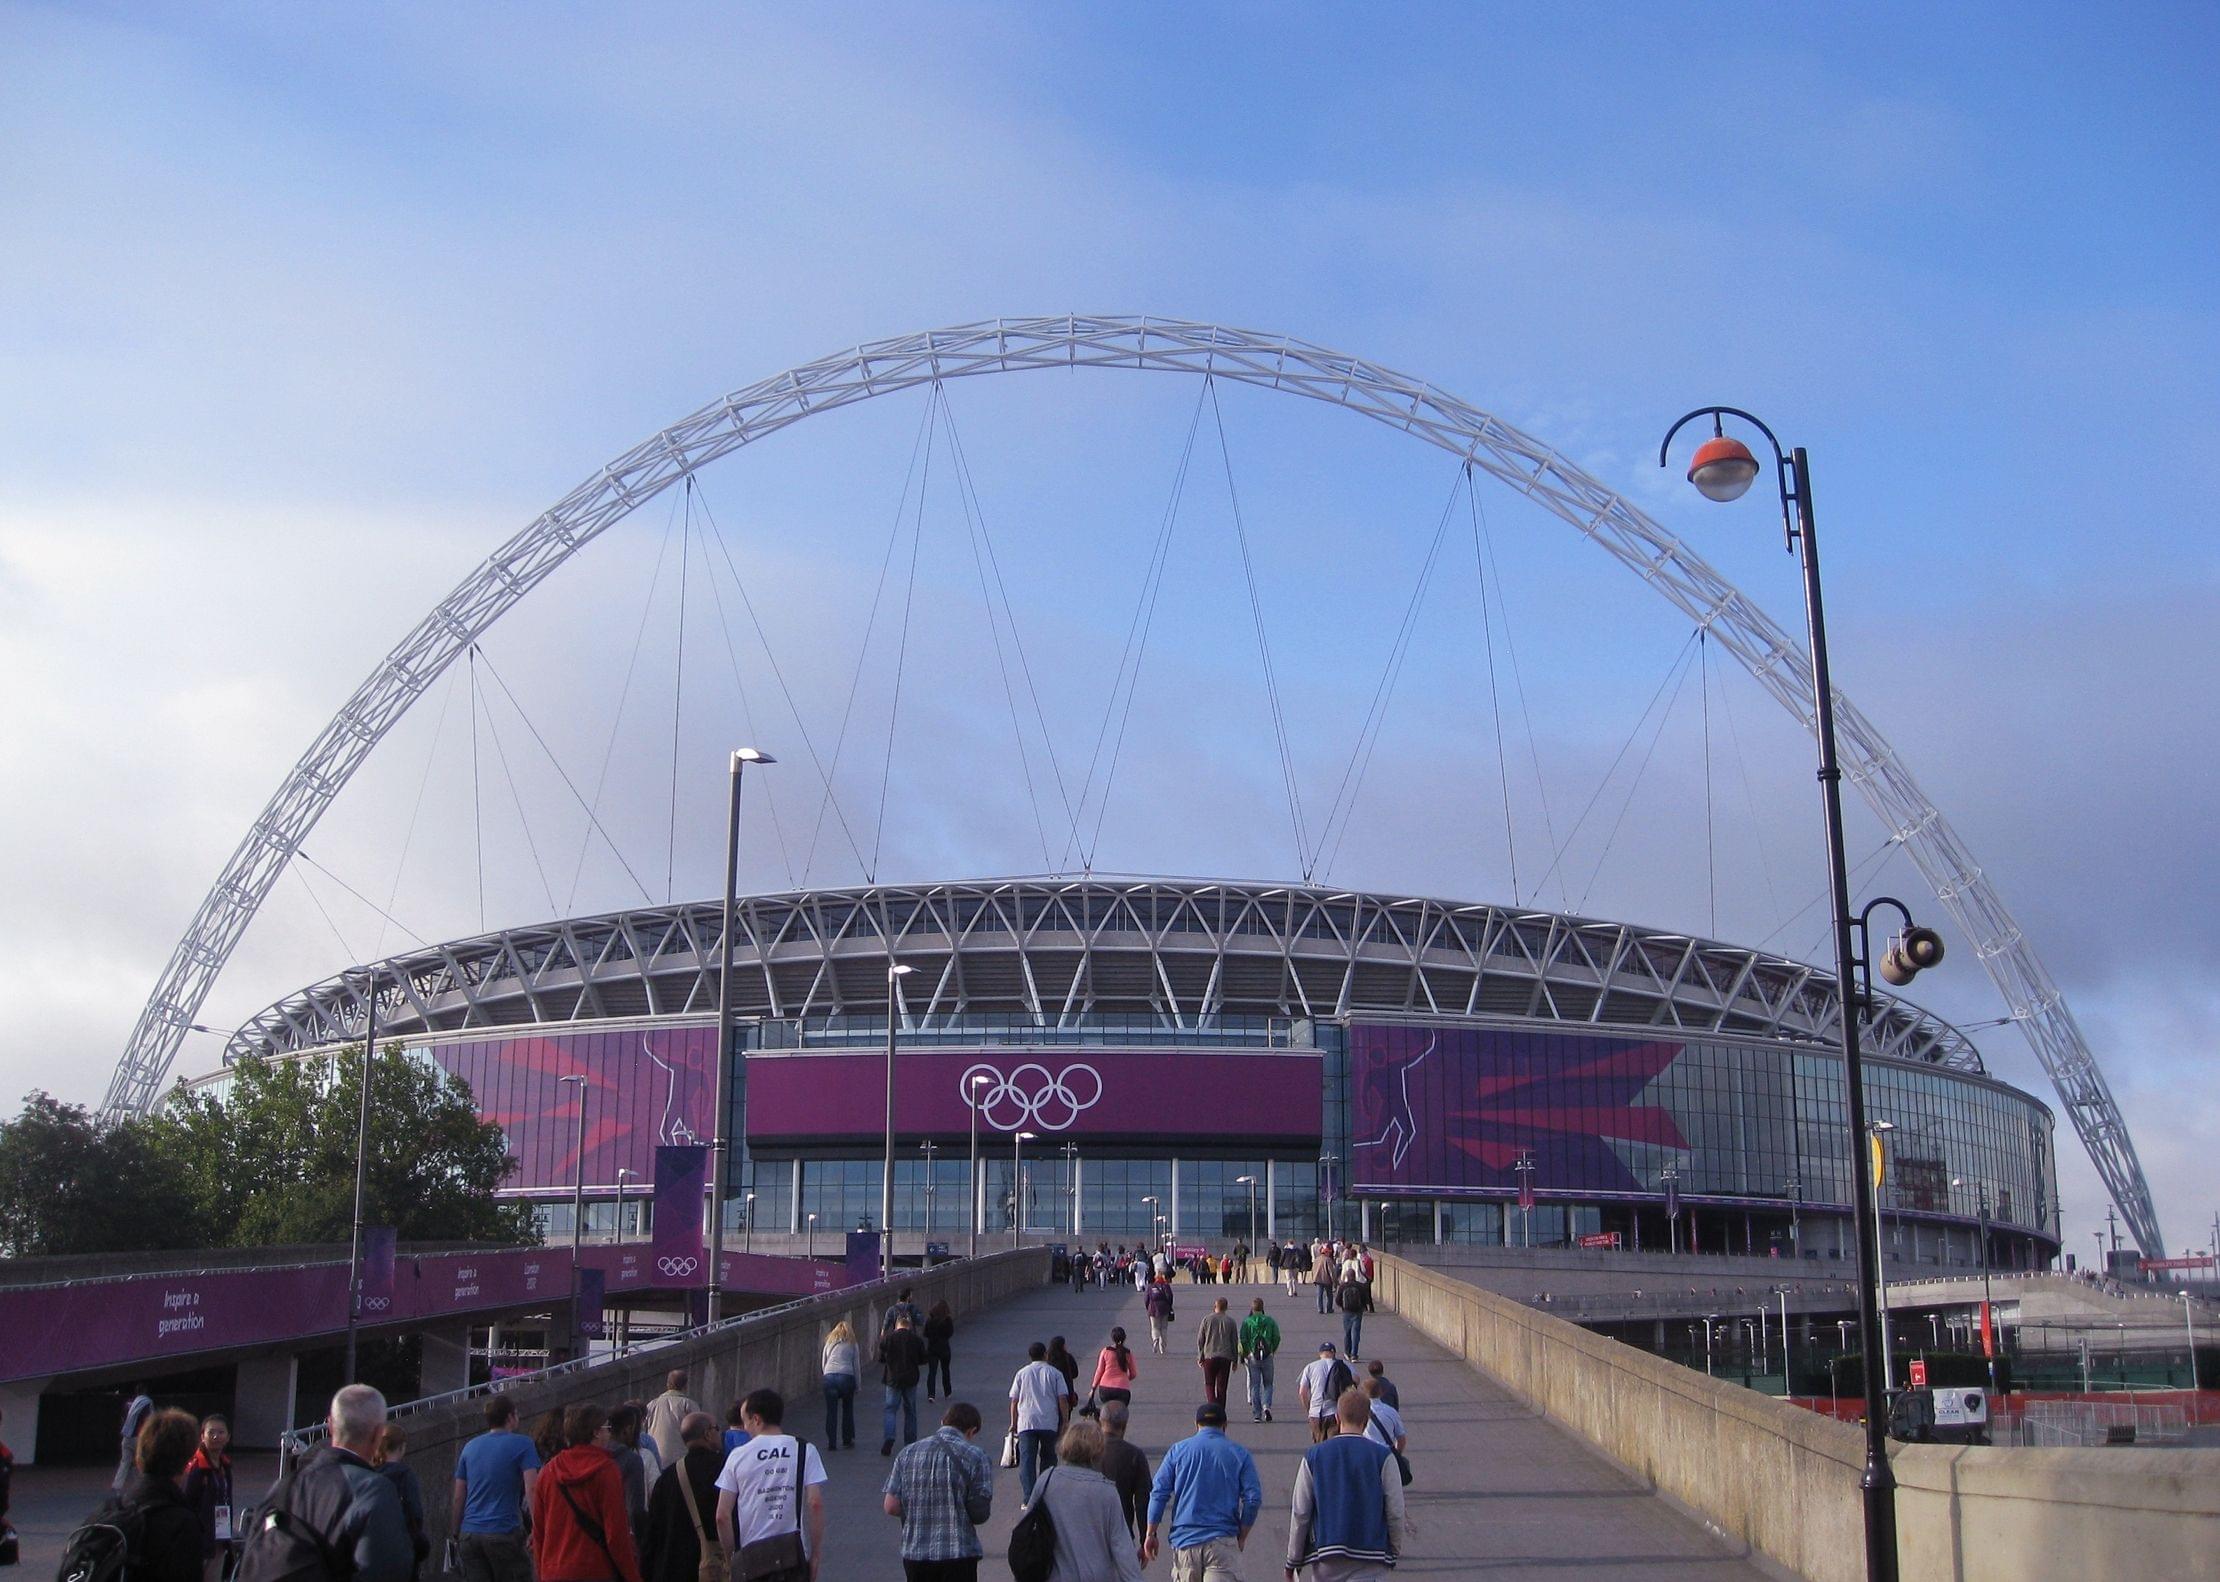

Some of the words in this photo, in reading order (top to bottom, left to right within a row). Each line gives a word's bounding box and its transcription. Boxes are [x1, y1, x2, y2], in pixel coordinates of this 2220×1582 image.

[164, 1288, 191, 1311] Inspire
[193, 1292, 200, 1305] a
[159, 1312, 204, 1338] generation
[756, 1446, 791, 1461] CAL
[757, 1485, 796, 1495] BADMINTON
